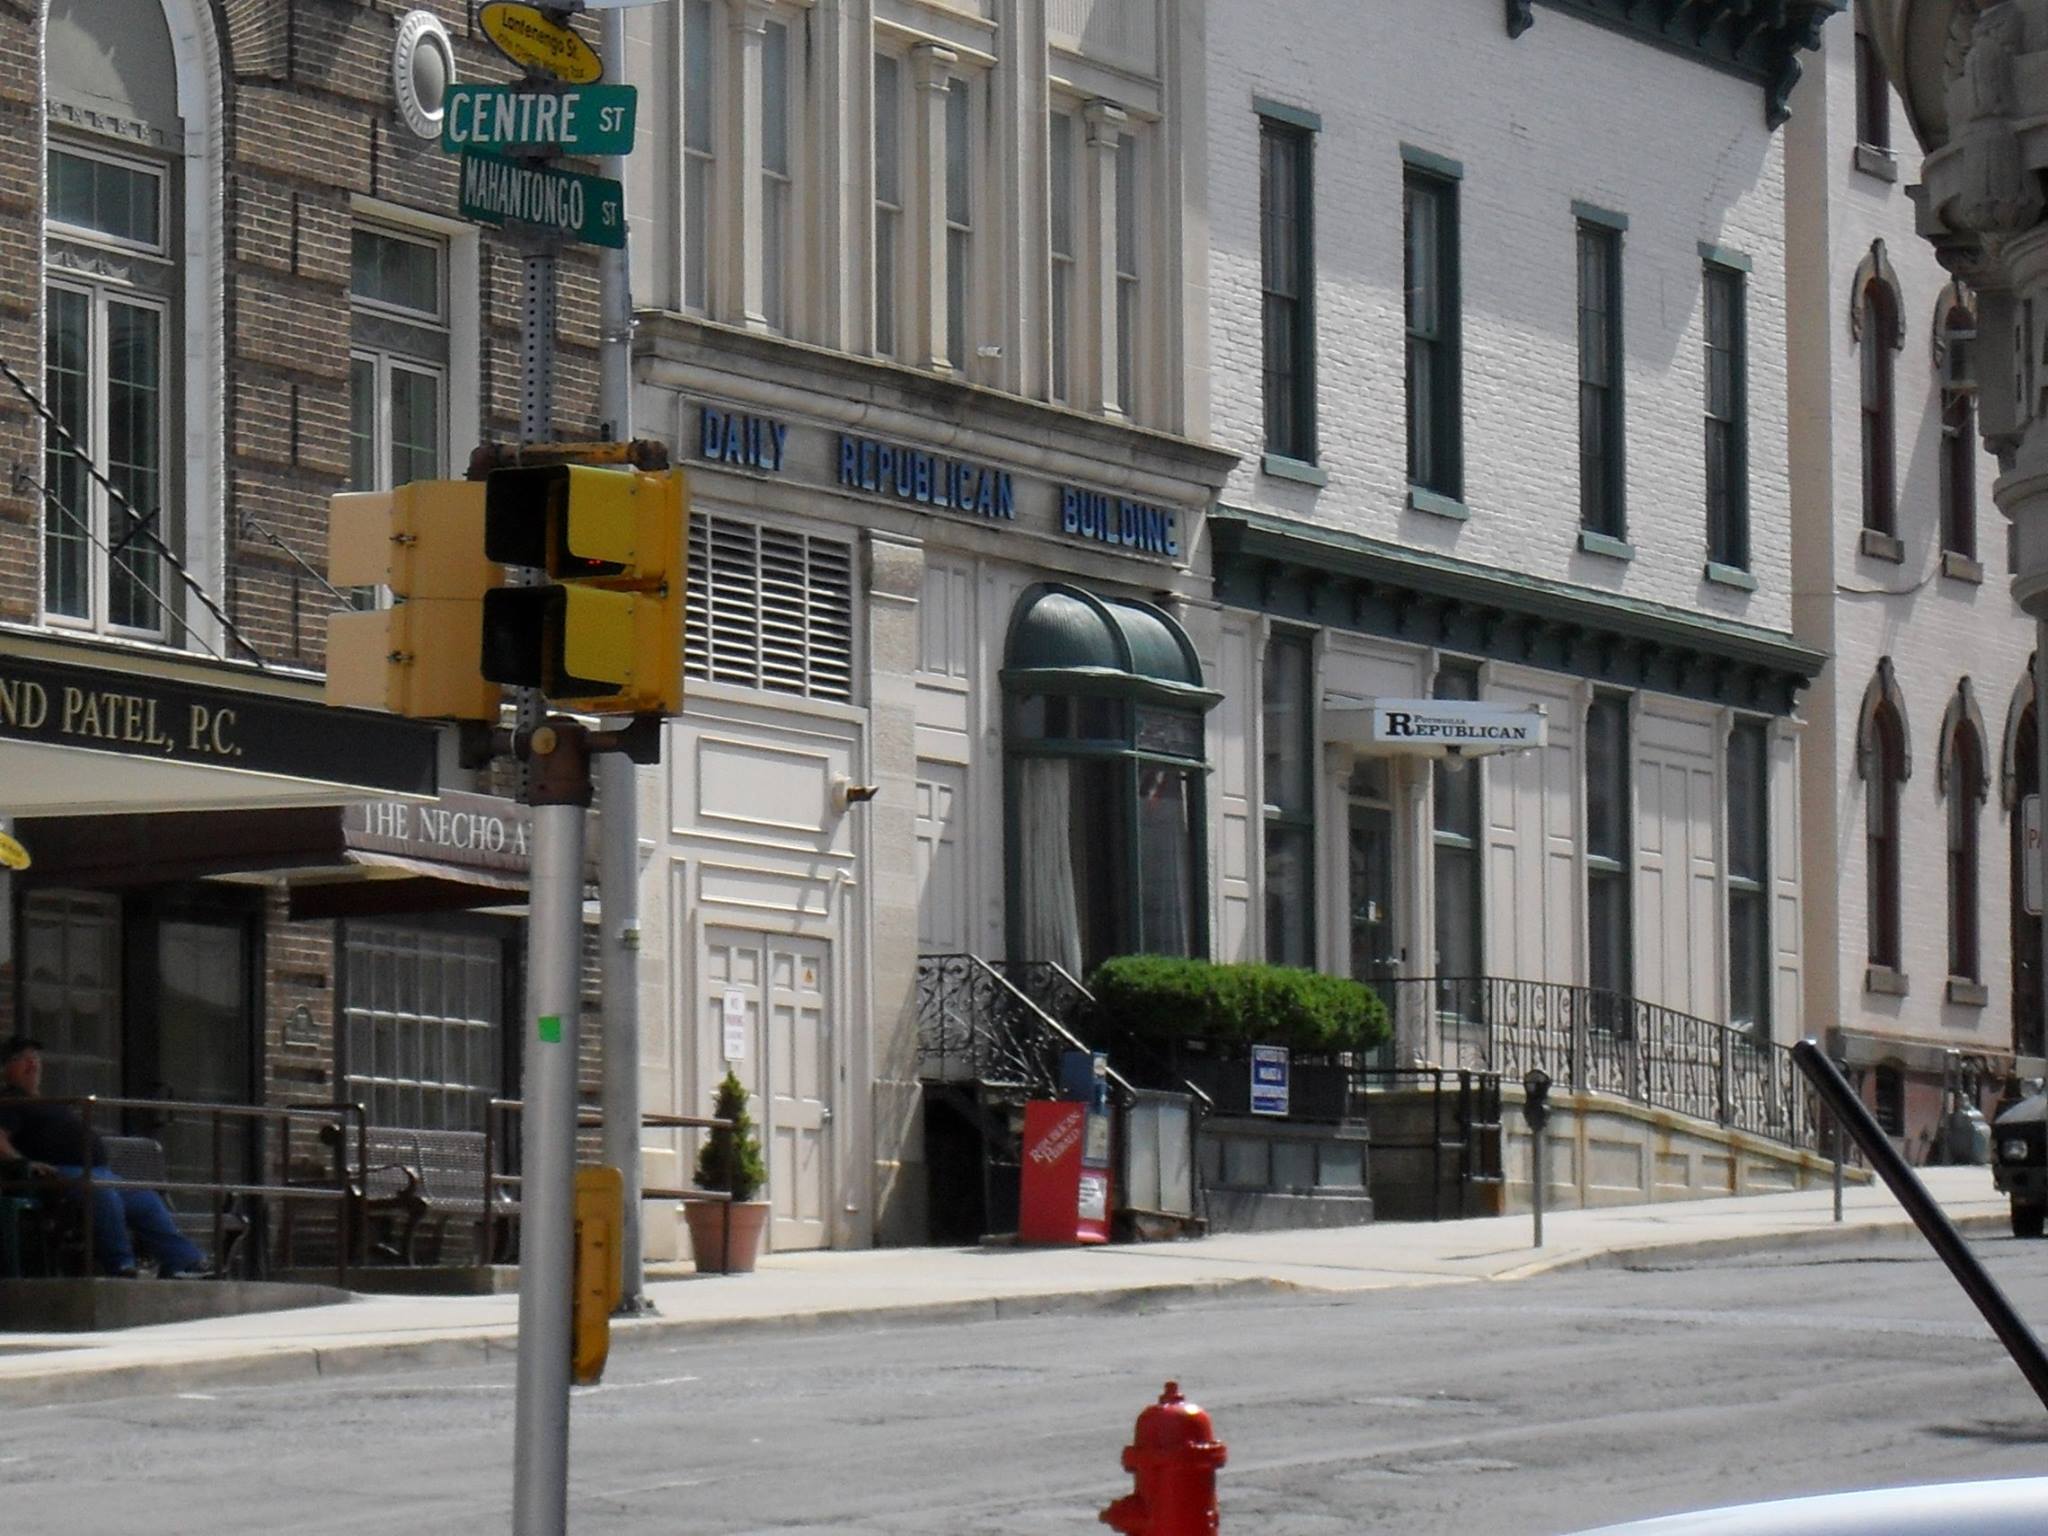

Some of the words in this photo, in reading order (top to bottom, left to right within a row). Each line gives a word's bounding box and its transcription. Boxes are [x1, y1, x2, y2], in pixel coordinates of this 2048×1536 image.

[450, 92, 580, 143] CENTRE
[599, 106, 625, 132] ST
[465, 156, 584, 230] MAHANTONGO
[602, 201, 617, 226] ST
[700, 407, 786, 471] DAILY
[838, 434, 1016, 520] REPUBLICAN
[1060, 484, 1179, 557] BUILDING
[62, 686, 175, 752] PATEL,
[187, 704, 243, 756] P.C.
[1385, 712, 1527, 739] REPUBLICAN
[364, 802, 409, 840] THE
[419, 807, 505, 852] NECHO
